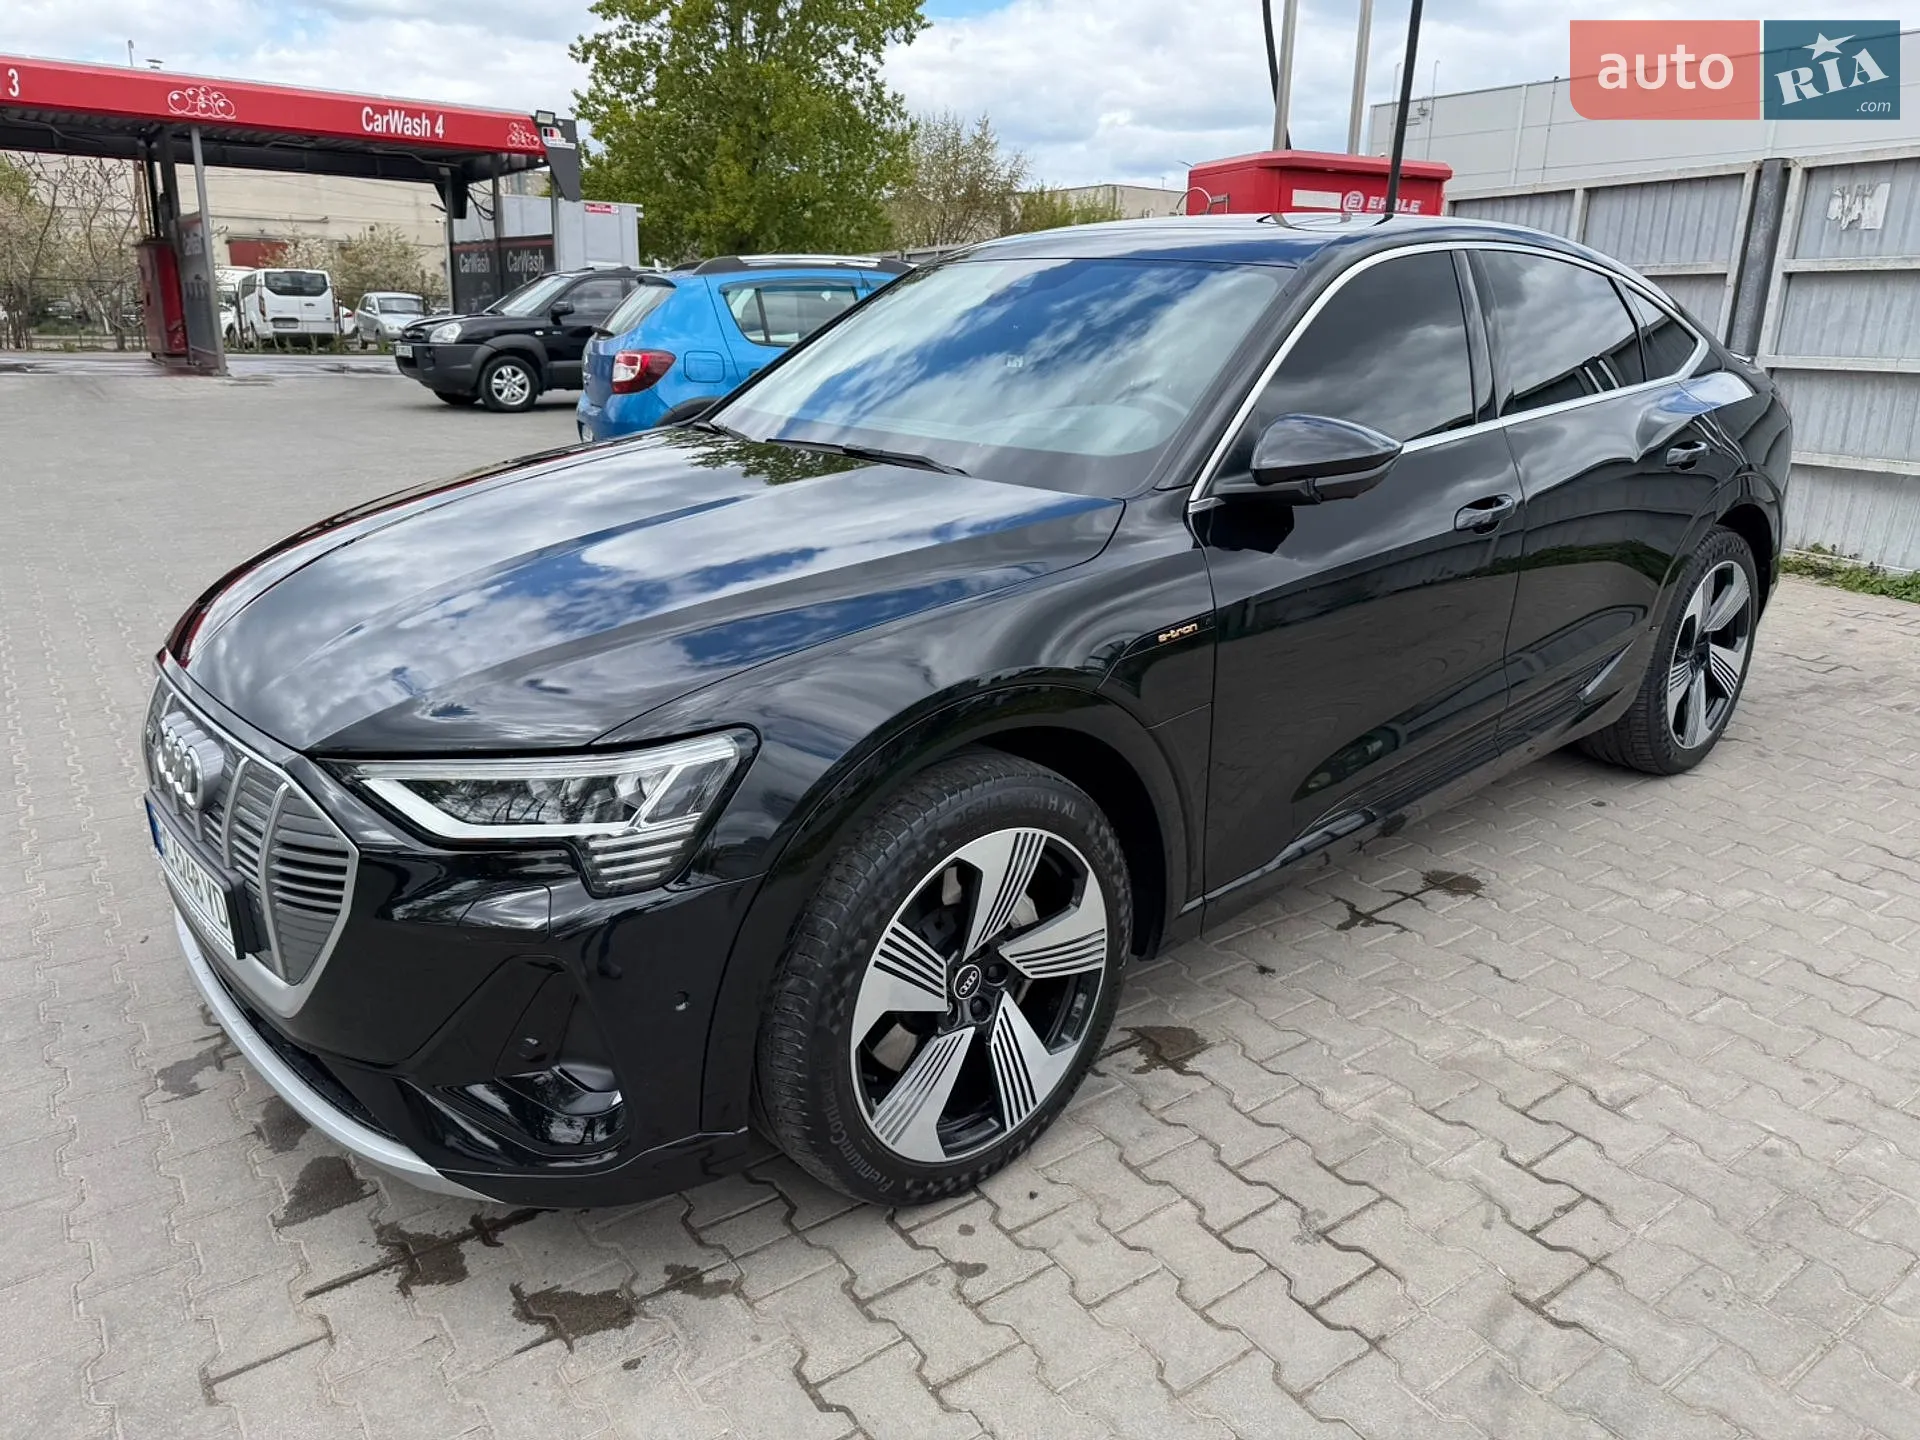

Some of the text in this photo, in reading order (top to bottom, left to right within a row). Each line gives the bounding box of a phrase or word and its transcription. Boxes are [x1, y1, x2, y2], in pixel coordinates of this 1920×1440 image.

[8, 68, 20, 98] 3
[361, 106, 444, 139] CarWash 4
[459, 253, 490, 273] CarWash
[507, 248, 545, 273] CarWash
[1157, 623, 1198, 643] e-tron
[1047, 795, 1059, 811] H
